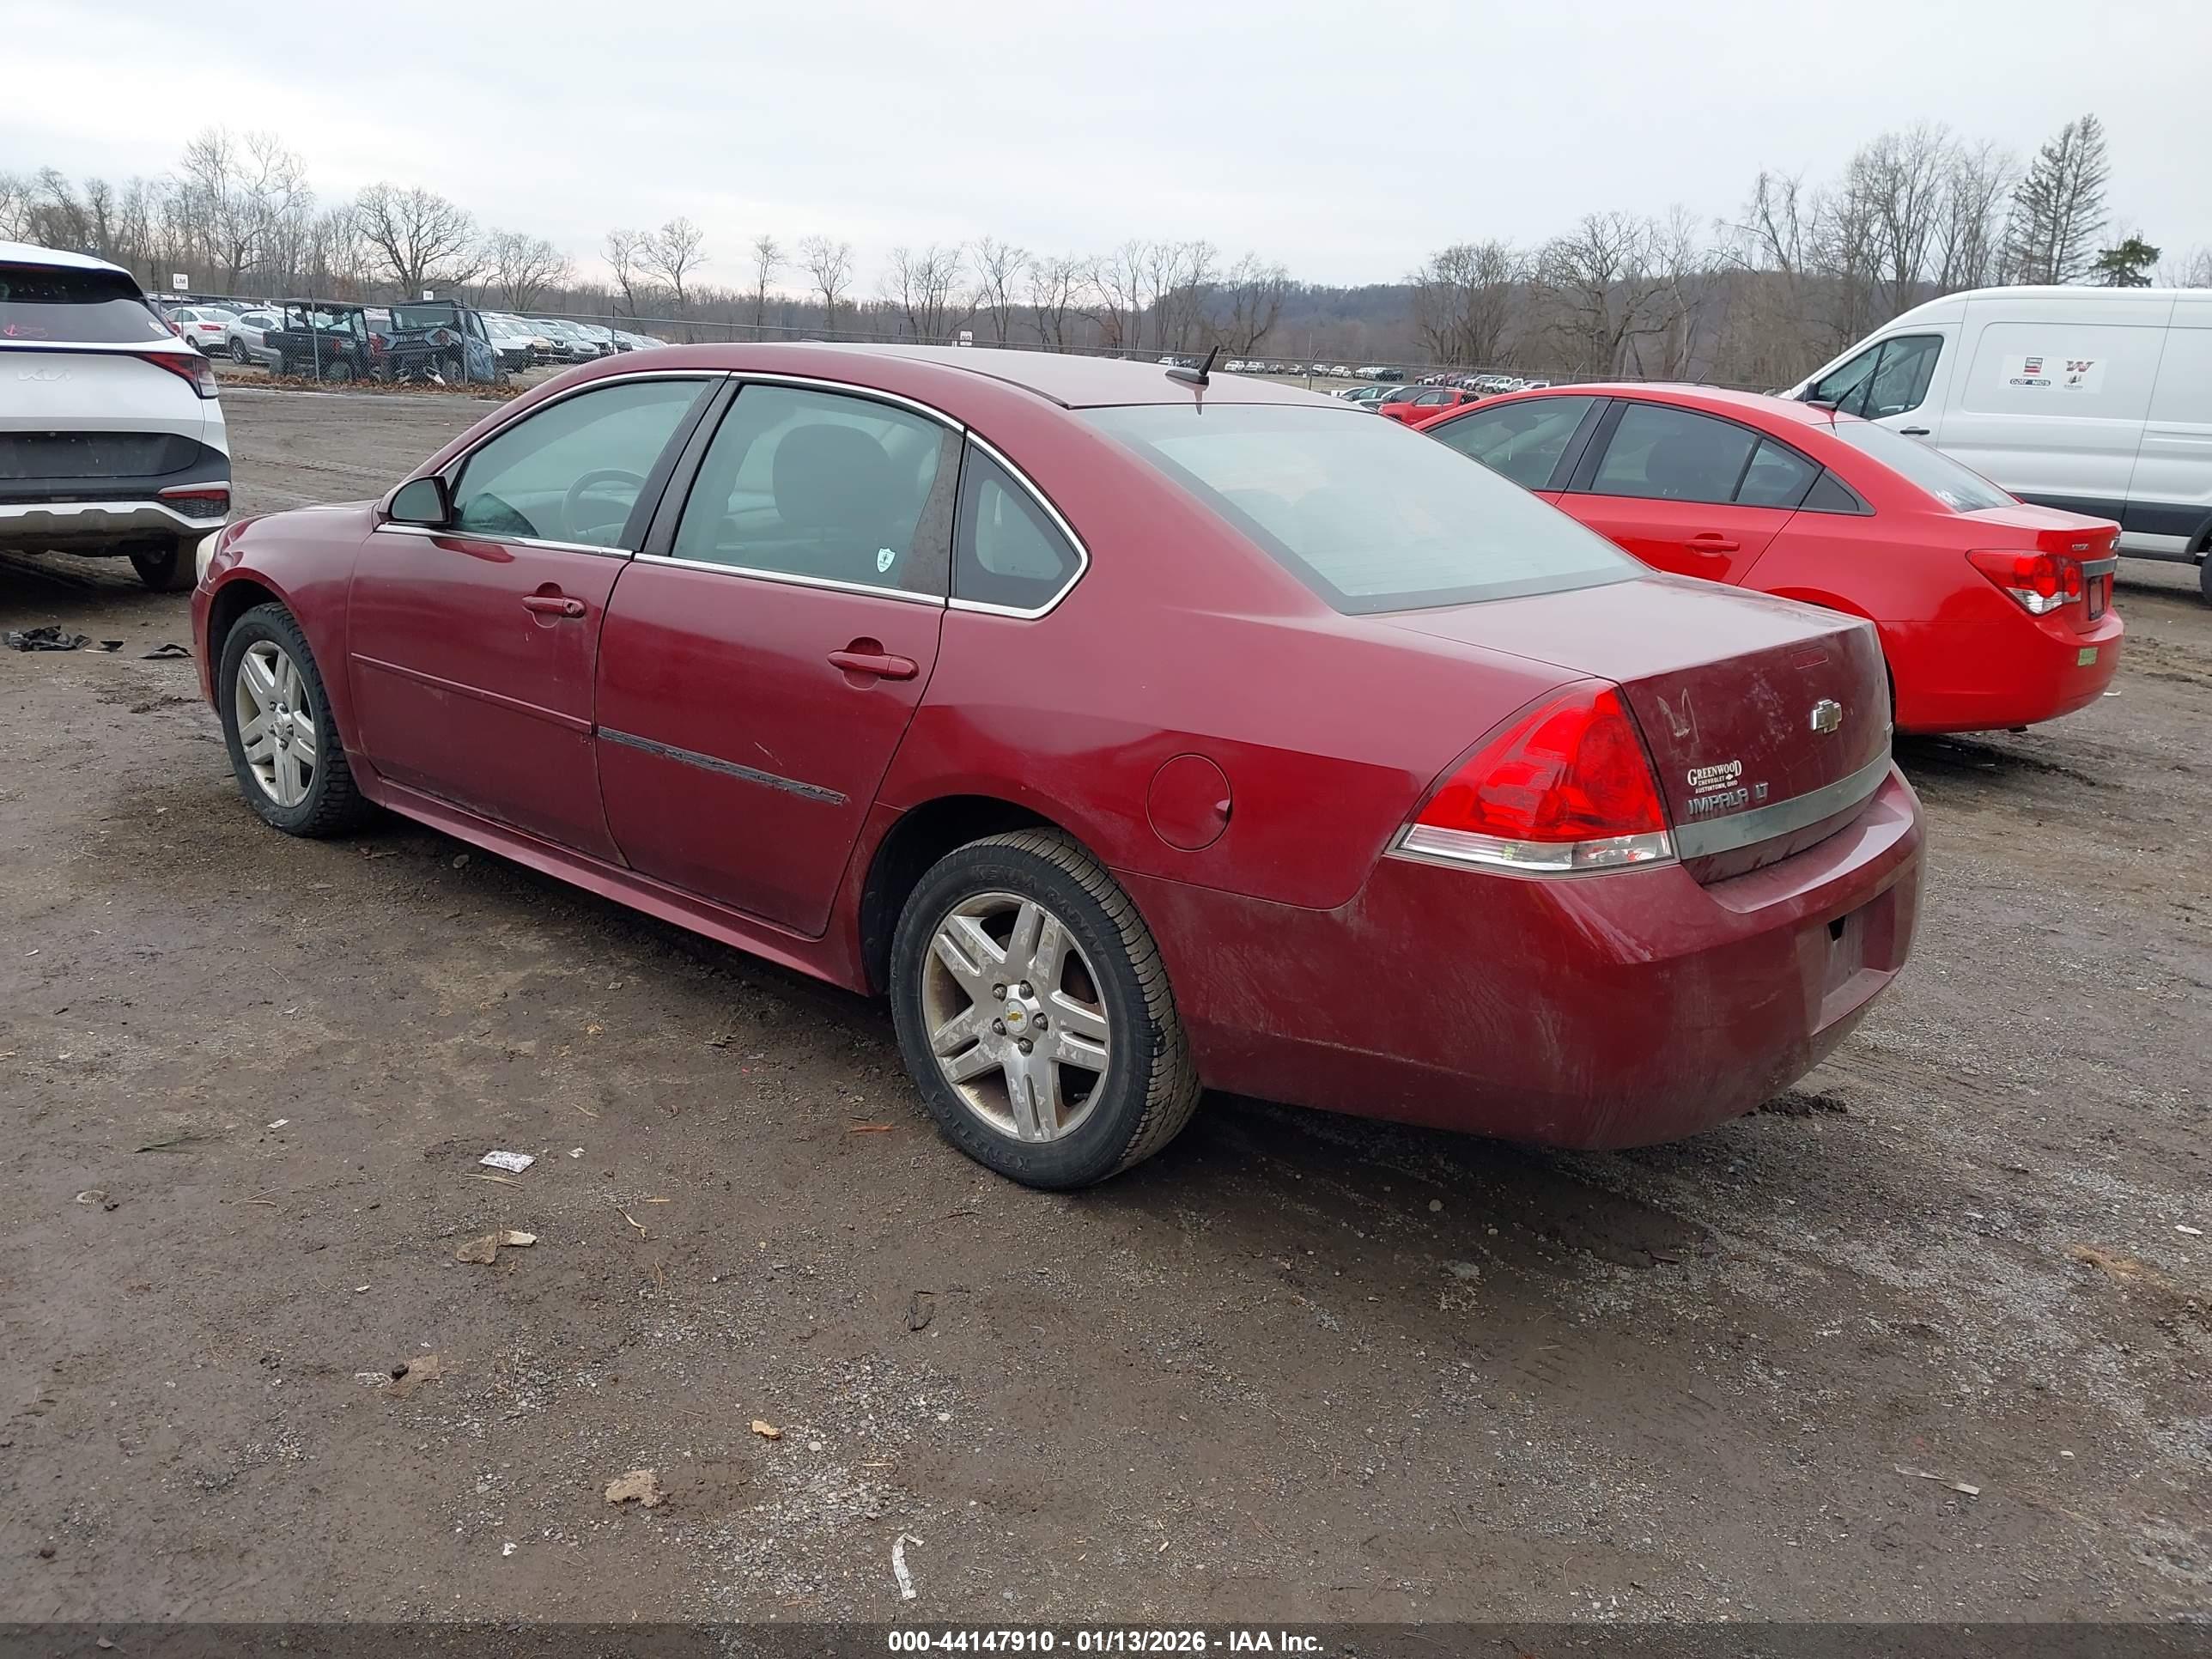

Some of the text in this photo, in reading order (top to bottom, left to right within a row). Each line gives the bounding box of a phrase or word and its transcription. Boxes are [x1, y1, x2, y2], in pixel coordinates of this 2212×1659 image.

[1687, 760, 1742, 786] GREENWOOD
[1698, 775, 1725, 787] CHEVROLET
[1688, 782, 1768, 815] IMPALA LT
